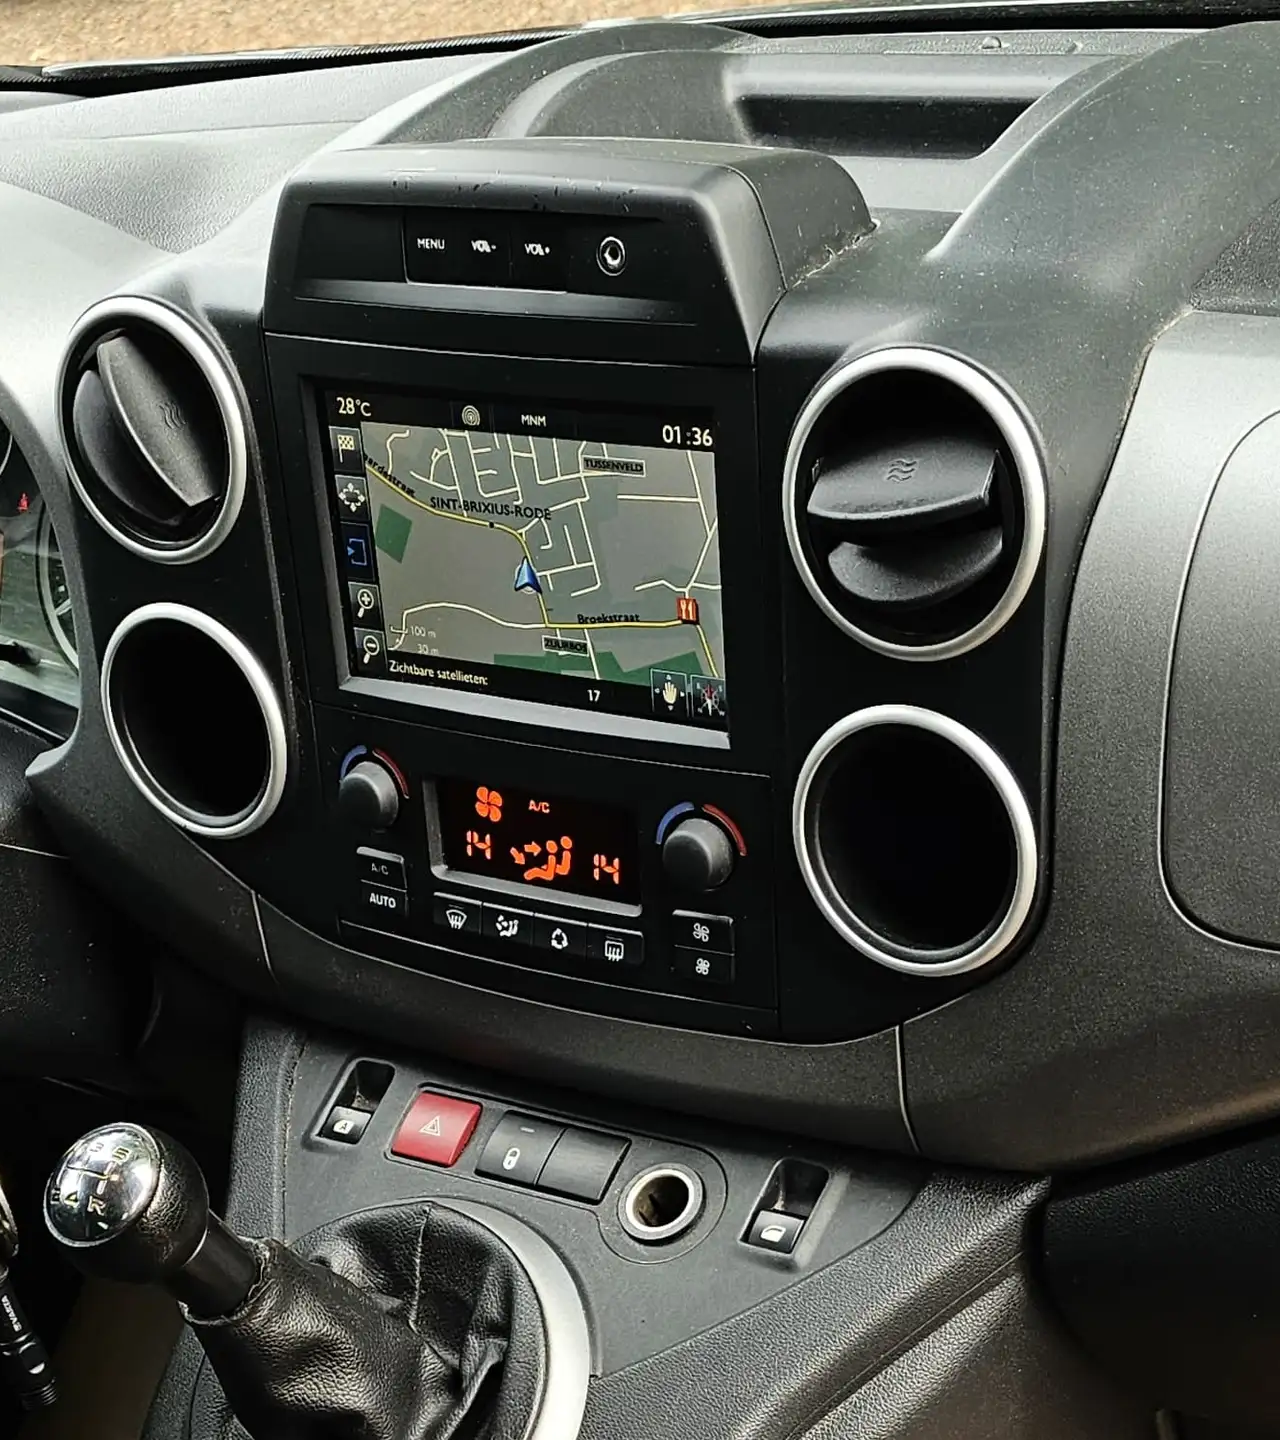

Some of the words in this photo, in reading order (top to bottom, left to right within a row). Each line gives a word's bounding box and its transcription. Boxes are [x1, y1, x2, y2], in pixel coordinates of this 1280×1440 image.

[417, 238, 445, 250] MENU
[336, 397, 372, 418] 28°C
[521, 414, 547, 427] MNM
[584, 458, 644, 473] TUSSENVELD
[430, 496, 552, 520] SINT-BRIXIUS-RODE
[577, 613, 640, 625] Broekstraat
[410, 626, 426, 638] 100
[427, 631, 437, 639] m
[417, 644, 429, 655] 30
[389, 660, 435, 678] Zichtbare
[437, 669, 489, 686] satellieten:
[587, 689, 601, 702] 17
[528, 799, 550, 814] A/C
[466, 830, 491, 860] 14
[371, 863, 389, 875] A/C
[593, 853, 620, 884] 14
[369, 891, 397, 909] AUTO
